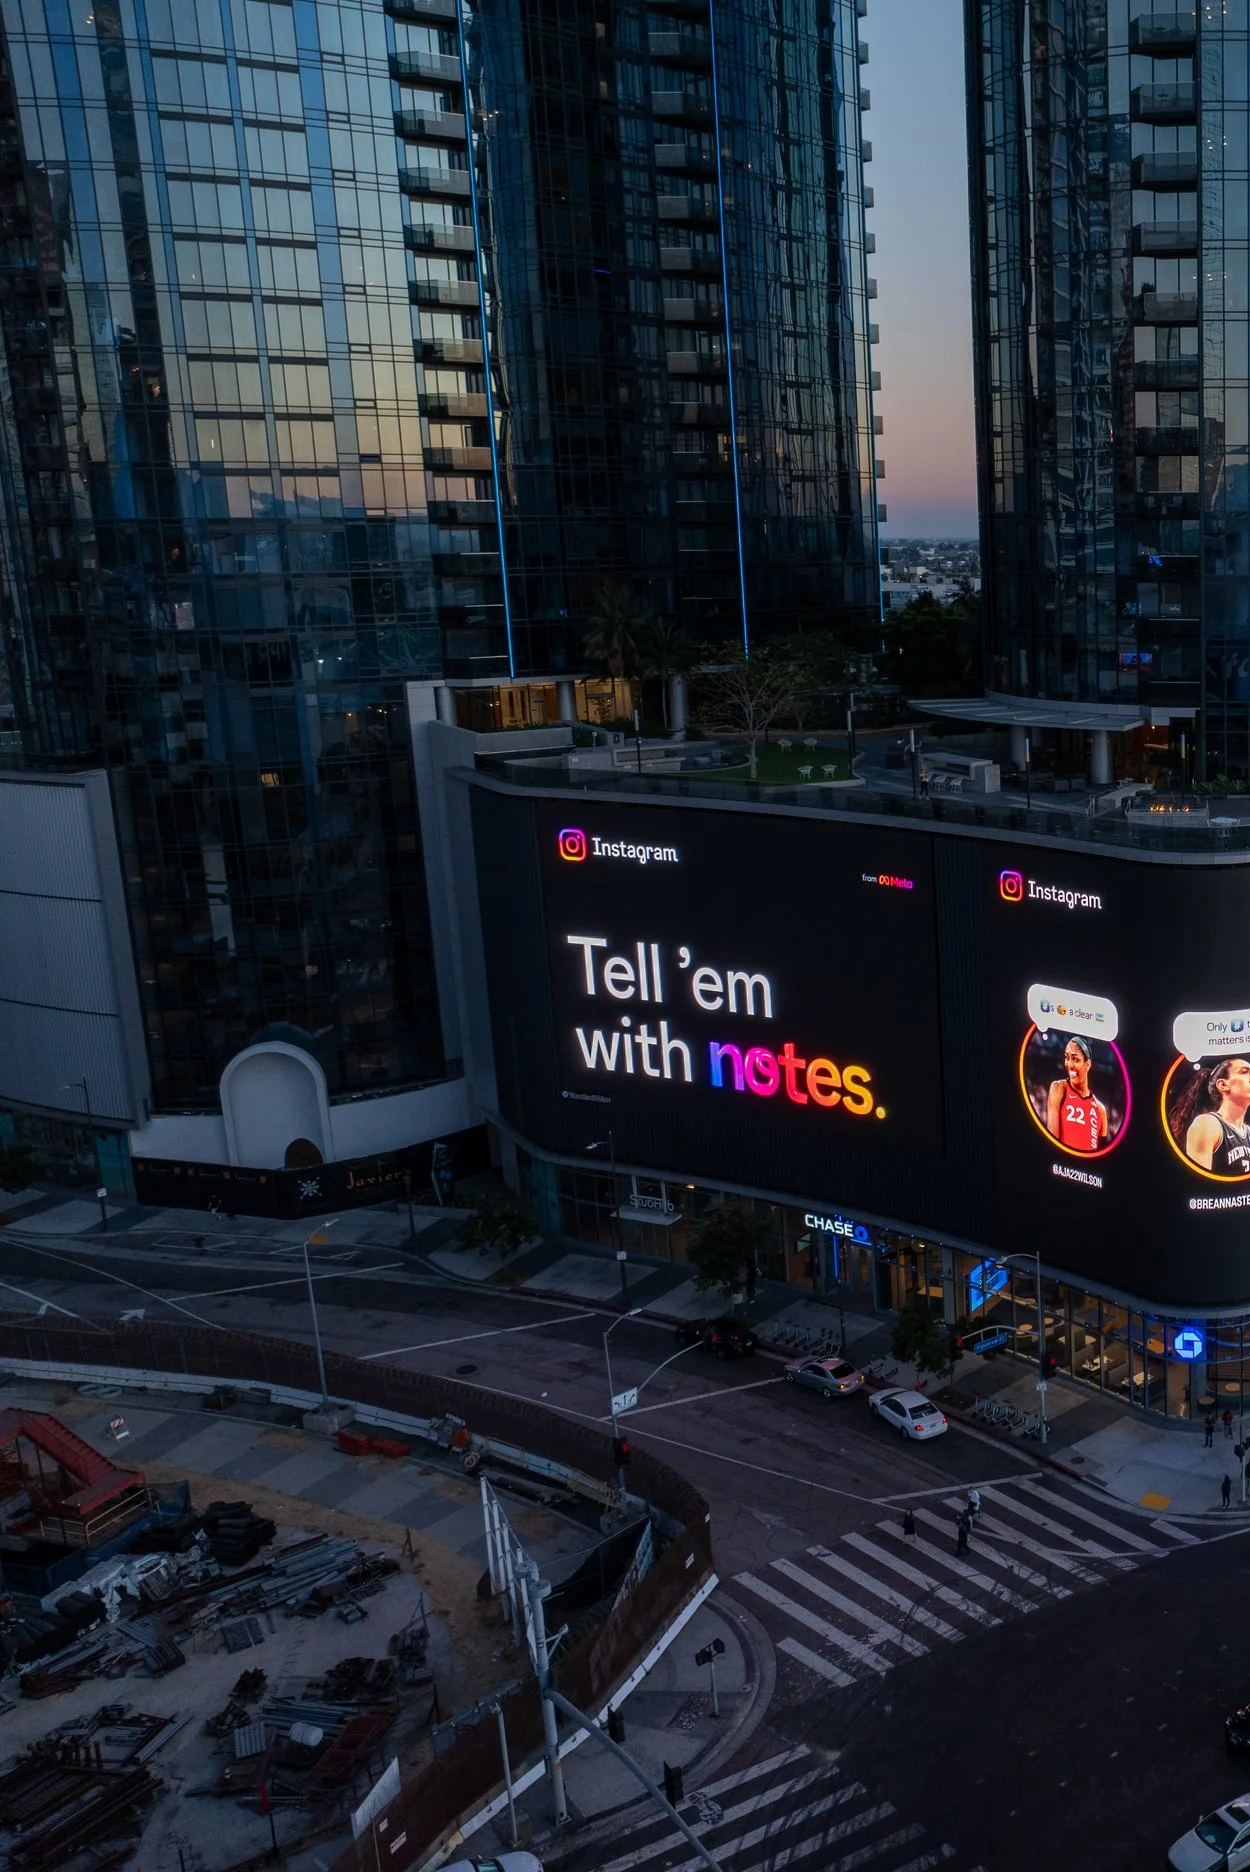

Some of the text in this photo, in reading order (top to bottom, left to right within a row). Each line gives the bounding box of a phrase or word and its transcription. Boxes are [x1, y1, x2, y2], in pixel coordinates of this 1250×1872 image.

[592, 837, 679, 864] Instagram
[861, 873, 913, 890] from Meta
[1028, 880, 1102, 909] Instagram
[567, 935, 773, 1019] Tell 'em
[1074, 1008, 1093, 1020] clear
[1206, 1022, 1228, 1033] Only
[1208, 1036, 1244, 1045] matters
[576, 1016, 887, 1119] with notes.
[1065, 1103, 1086, 1125] 22
[1089, 1107, 1098, 1150] ACES
[347, 1167, 411, 1189] Javier'
[1052, 1164, 1102, 1188] @AJA22WILSON
[630, 1194, 674, 1211] SubHb
[804, 1213, 854, 1238] CHASE
